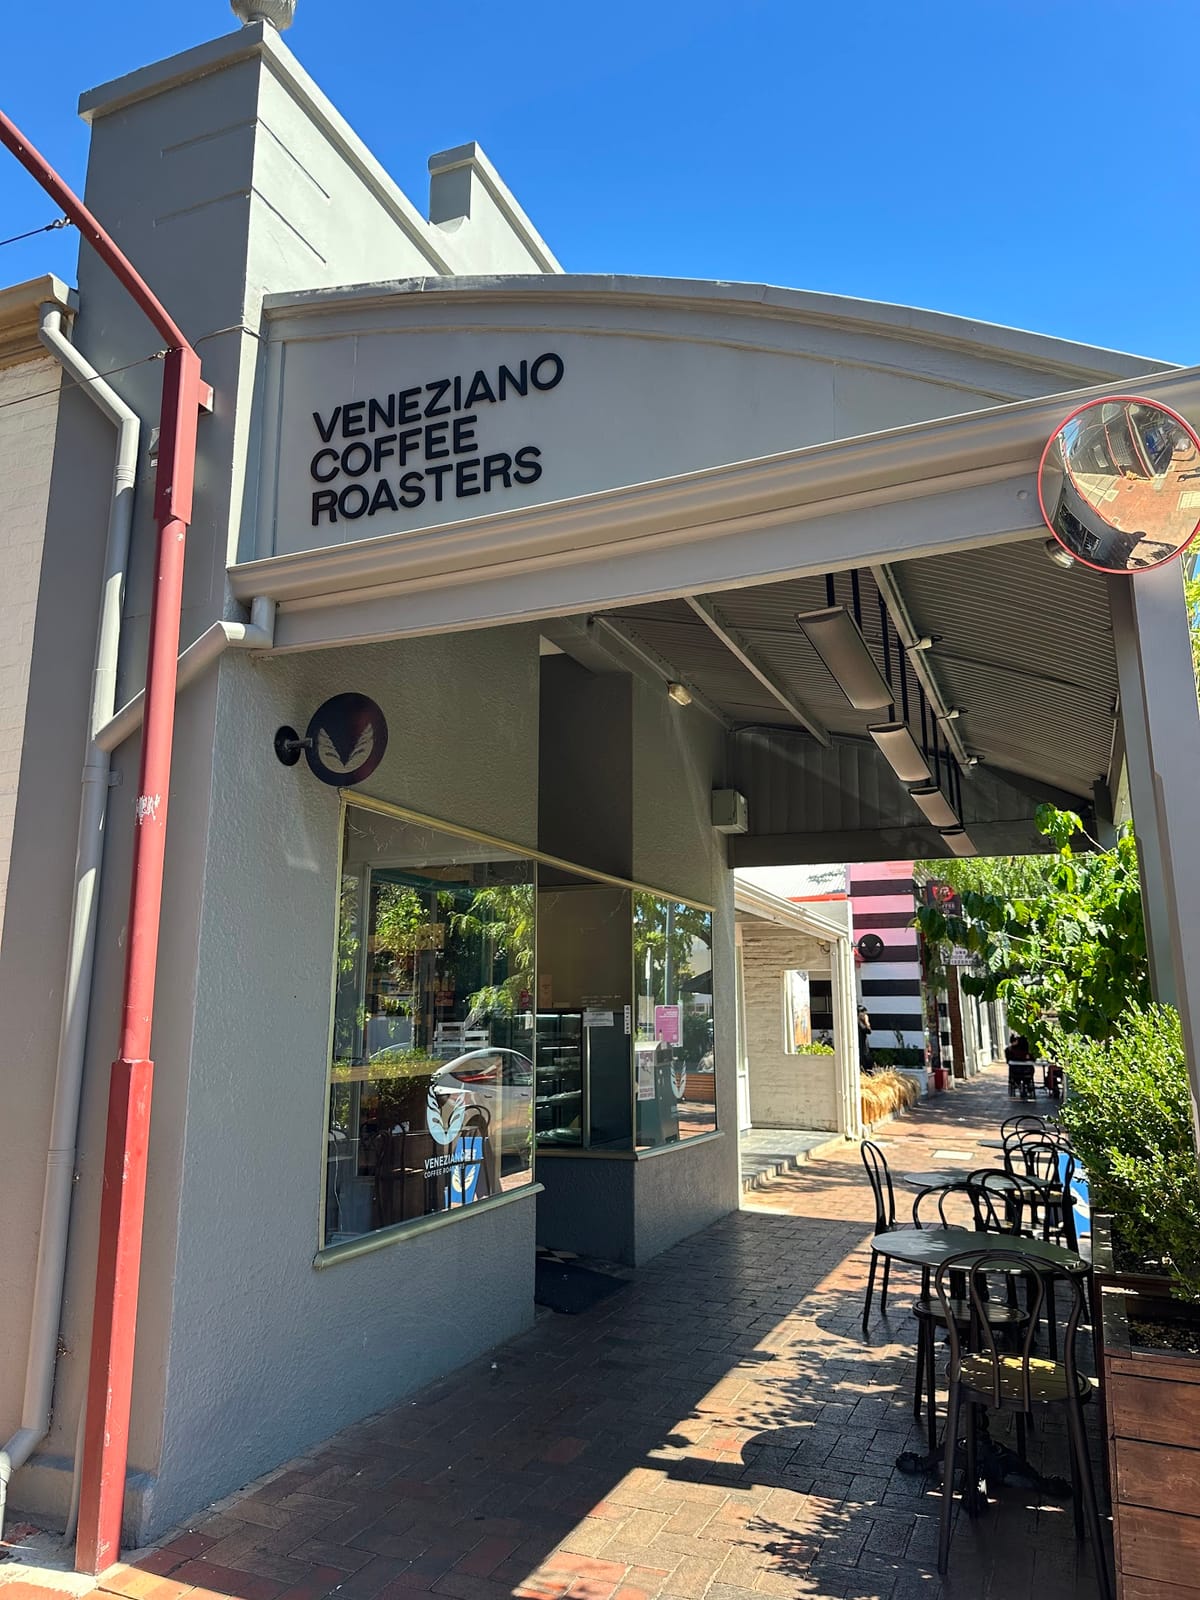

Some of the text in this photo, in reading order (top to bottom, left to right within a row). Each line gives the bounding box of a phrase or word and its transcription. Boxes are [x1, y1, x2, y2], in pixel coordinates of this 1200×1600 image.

[312, 352, 564, 443] VENEZIANO
[310, 415, 478, 483] COFFEE
[311, 446, 543, 526] ROASTERS
